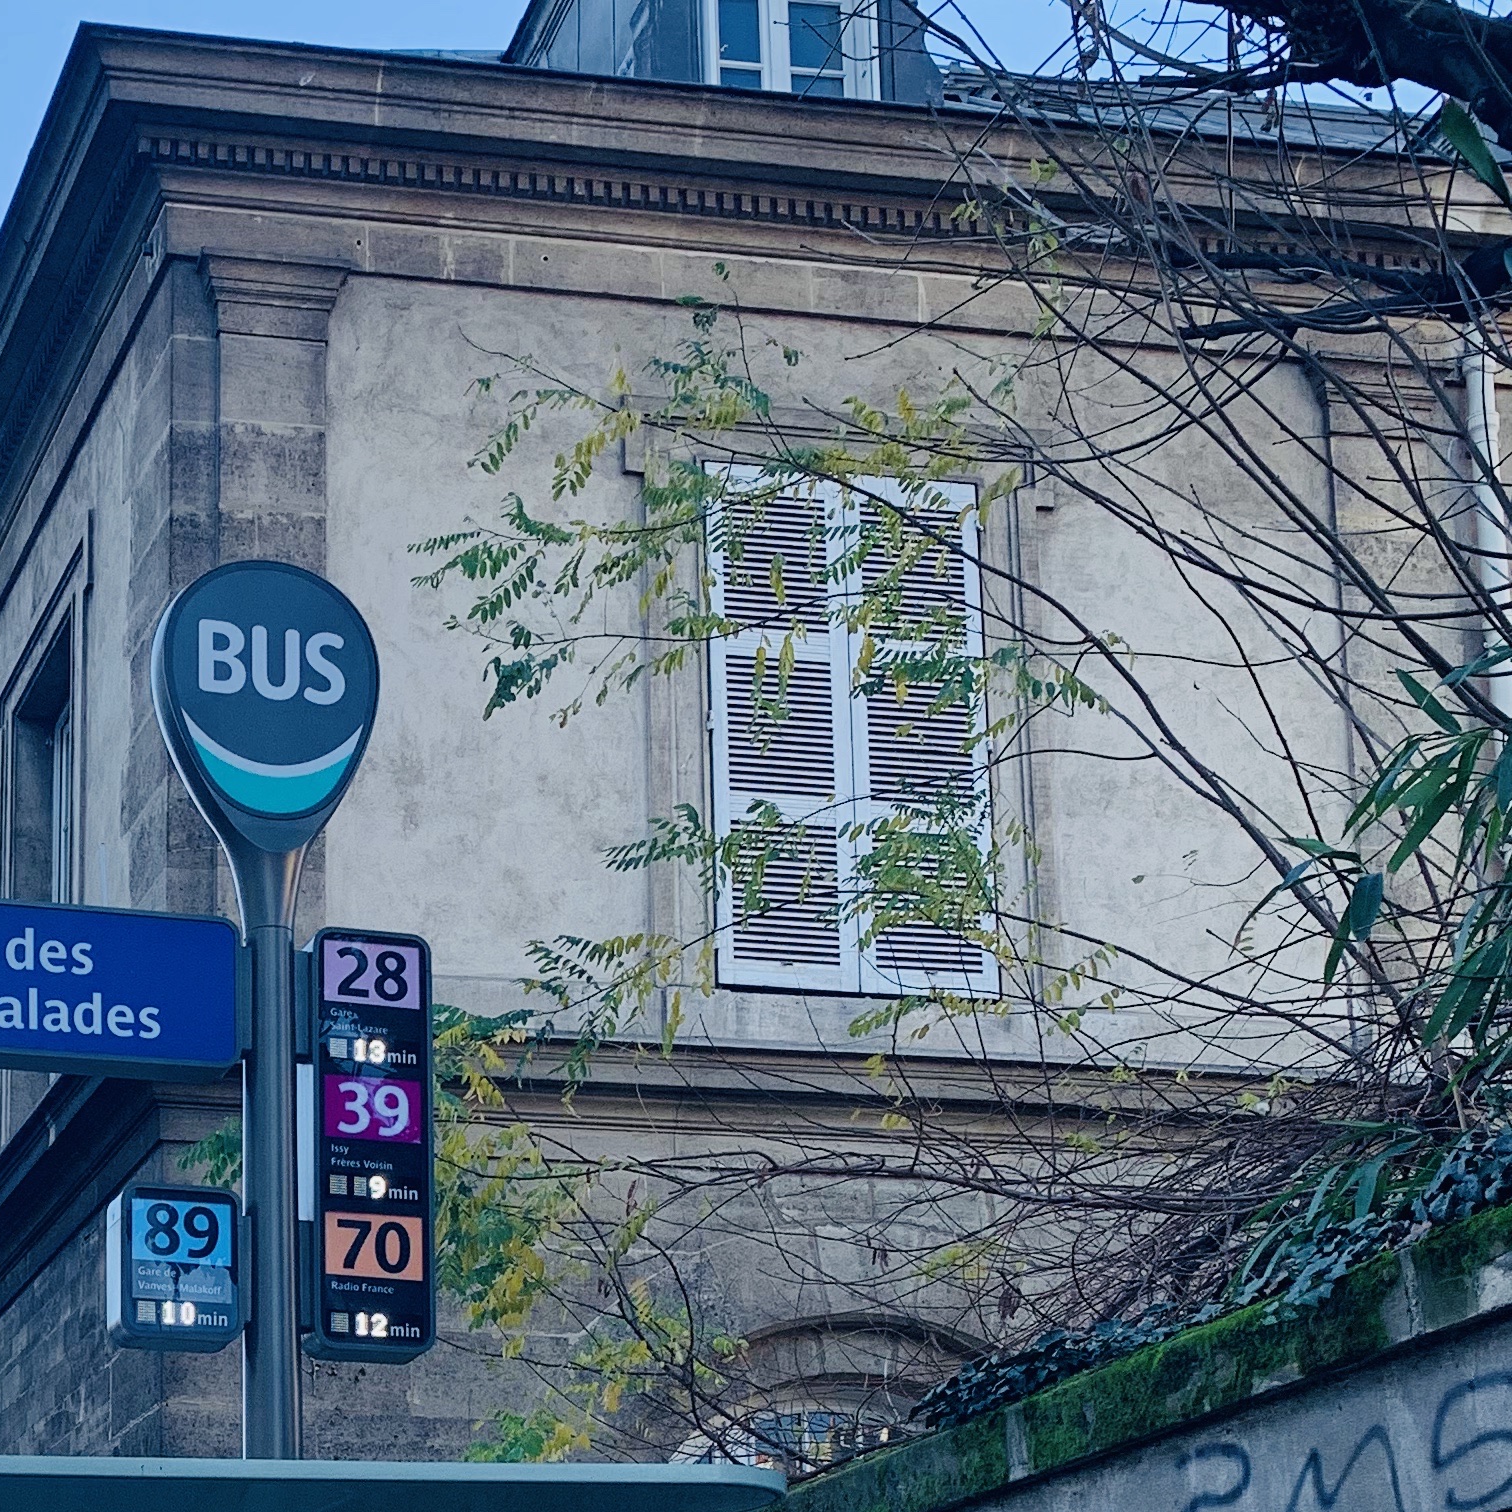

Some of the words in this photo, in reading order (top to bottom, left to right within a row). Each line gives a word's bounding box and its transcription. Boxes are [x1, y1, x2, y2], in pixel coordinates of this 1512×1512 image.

[198, 618, 346, 706] BUS
[5, 926, 94, 976] des
[336, 946, 409, 1002] 28
[330, 1007, 355, 1019] Gare
[353, 1037, 387, 1064] 13
[387, 1050, 417, 1065] min
[337, 1081, 409, 1137] 39
[331, 1143, 350, 1155] Issy
[331, 1157, 361, 1168] Frères
[363, 1160, 393, 1170] Voisin
[369, 1175, 387, 1199] 9
[388, 1186, 419, 1201] min
[144, 1203, 220, 1259] 89
[336, 1218, 411, 1274] 70
[138, 1266, 161, 1277] Gare
[163, 1267, 177, 1278] de
[331, 1281, 360, 1291] Radio
[361, 1283, 395, 1295] France
[161, 1300, 196, 1325] 10
[197, 1312, 228, 1327] min
[355, 1311, 388, 1337] 12
[390, 1323, 421, 1338] min
